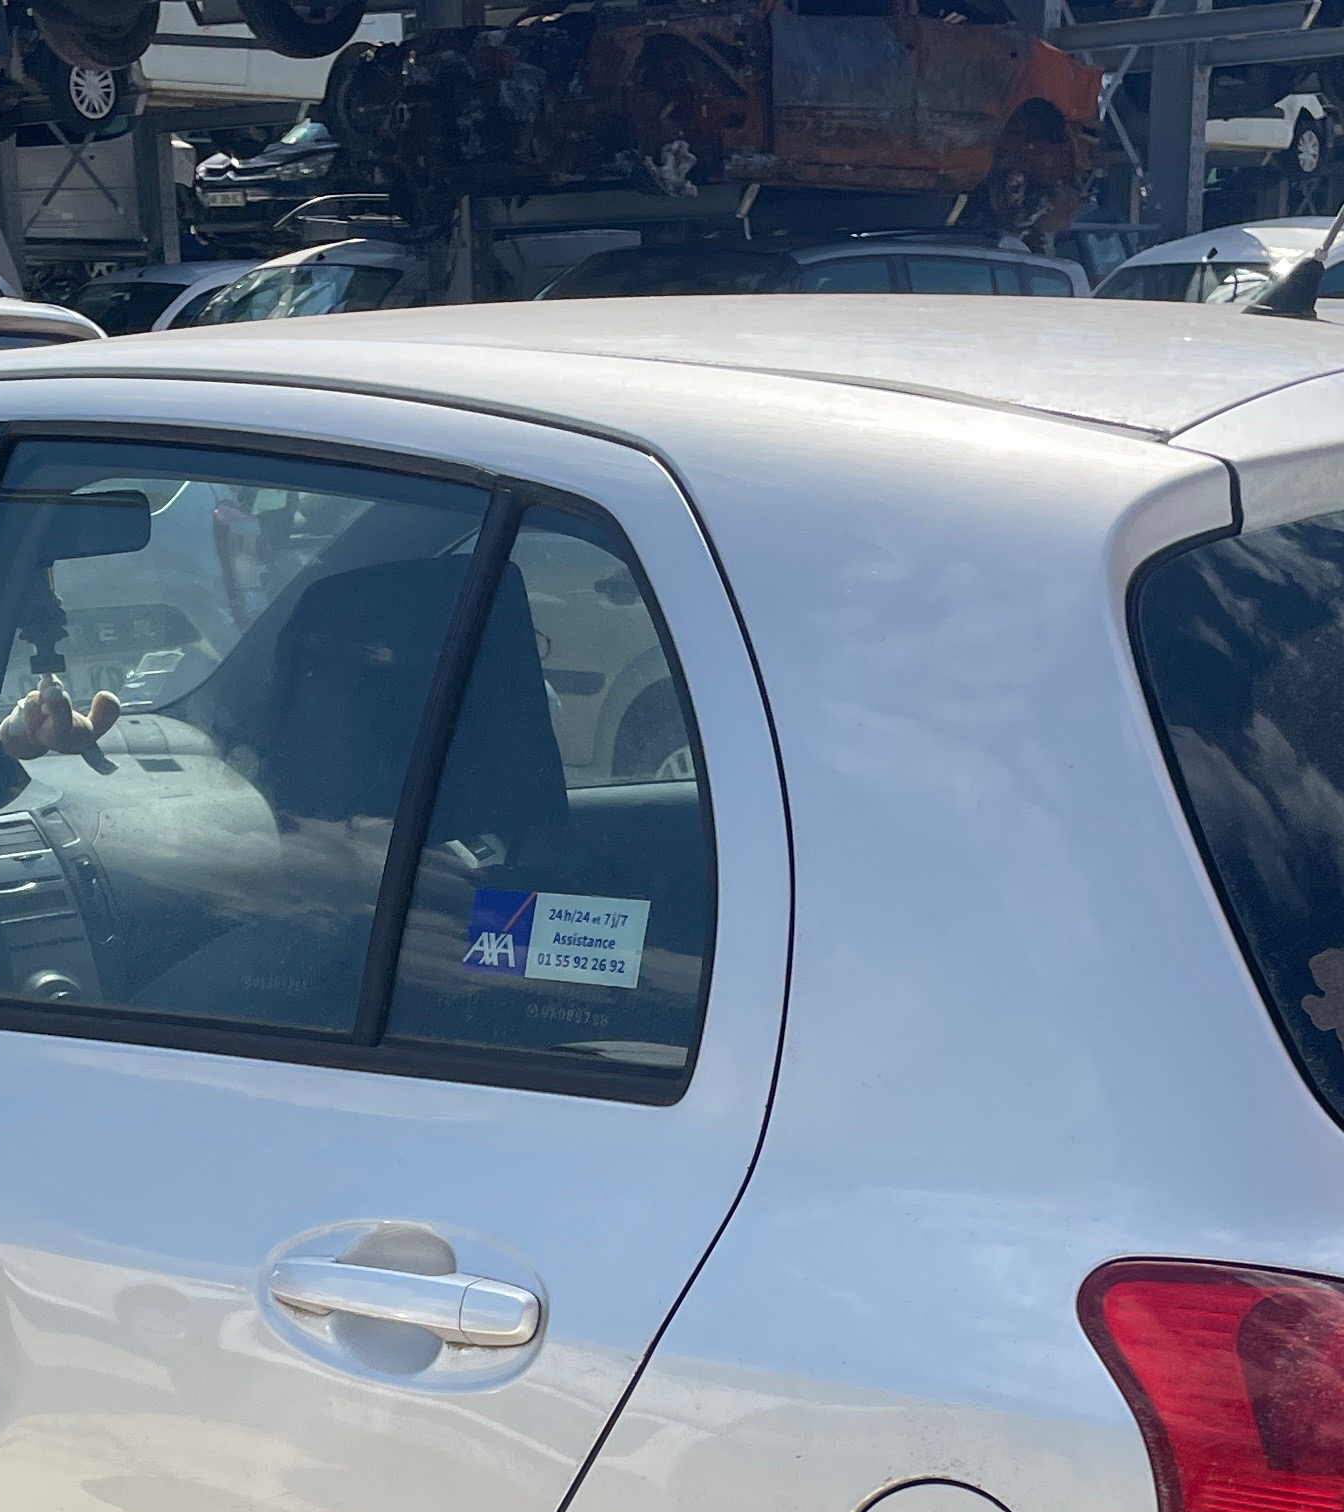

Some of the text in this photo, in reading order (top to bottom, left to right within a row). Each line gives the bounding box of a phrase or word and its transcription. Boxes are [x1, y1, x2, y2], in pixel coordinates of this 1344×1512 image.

[463, 931, 516, 968] AXA
[552, 931, 616, 950] Assistance
[537, 952, 626, 974] 01 55 92 26 92
